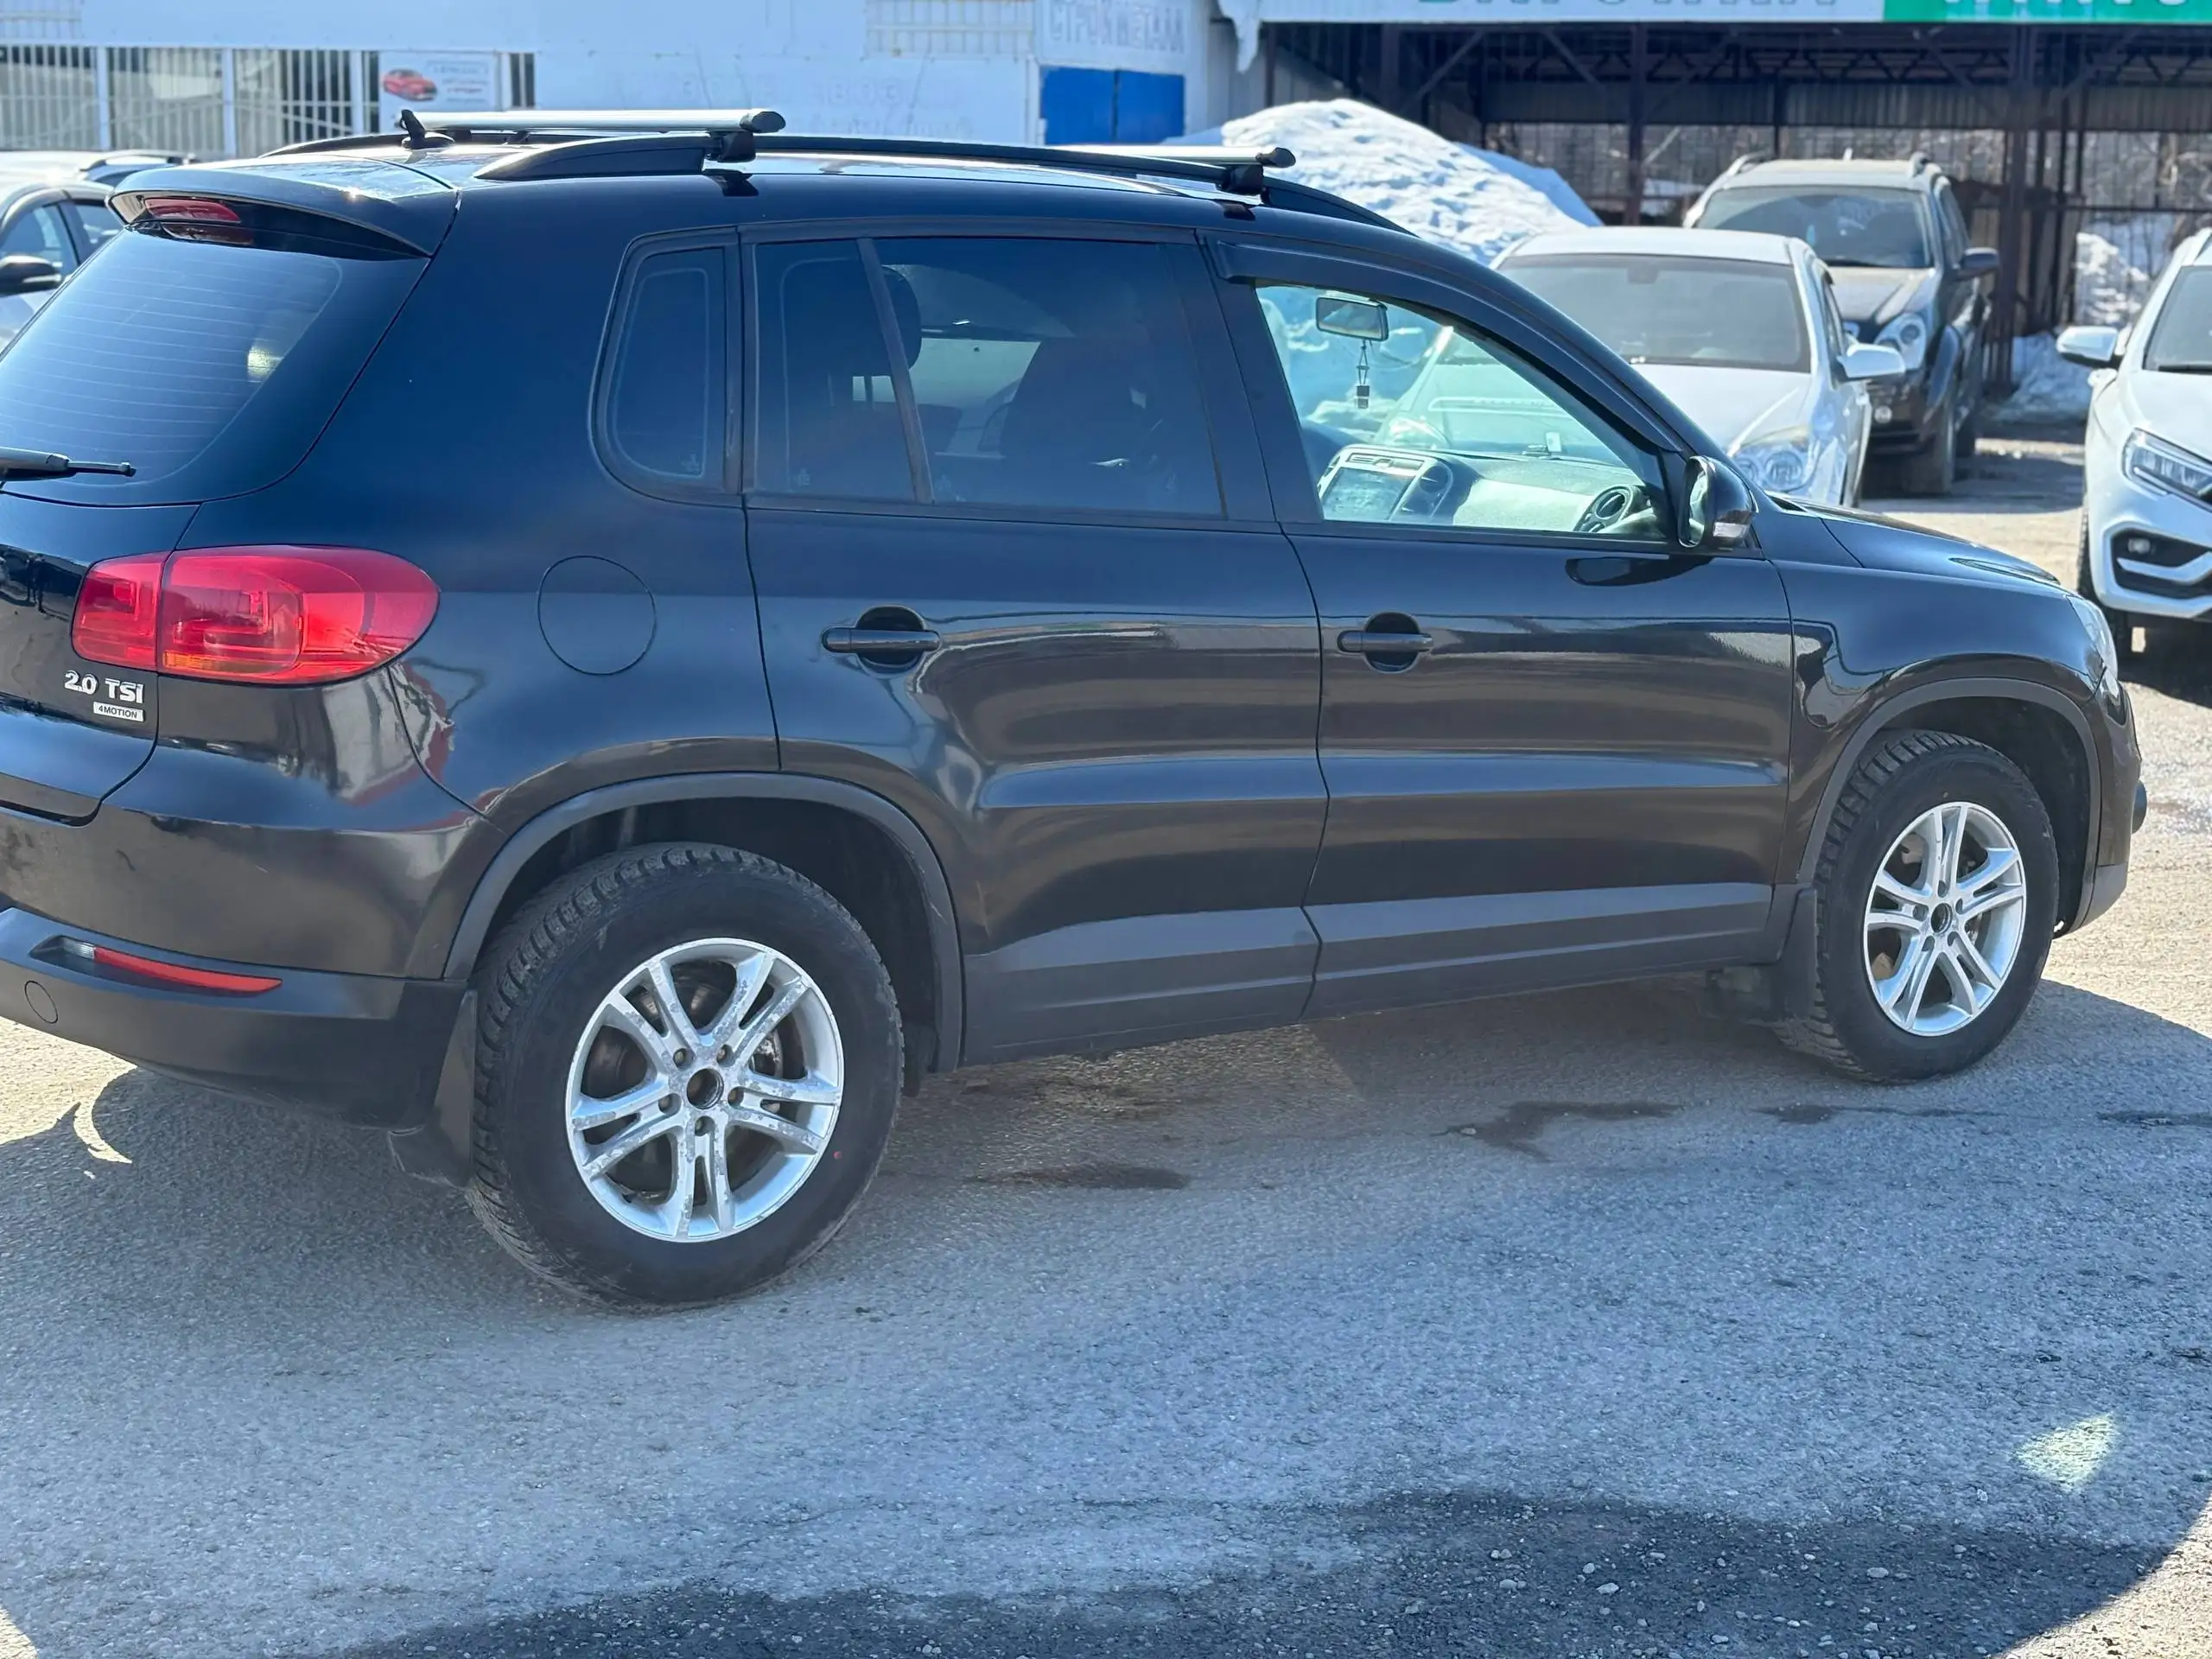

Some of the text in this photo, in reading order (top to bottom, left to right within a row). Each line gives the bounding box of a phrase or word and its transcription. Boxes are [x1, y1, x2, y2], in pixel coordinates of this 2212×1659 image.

[64, 670, 144, 703] 2.0 TSI
[98, 704, 138, 719] 4MOTION
